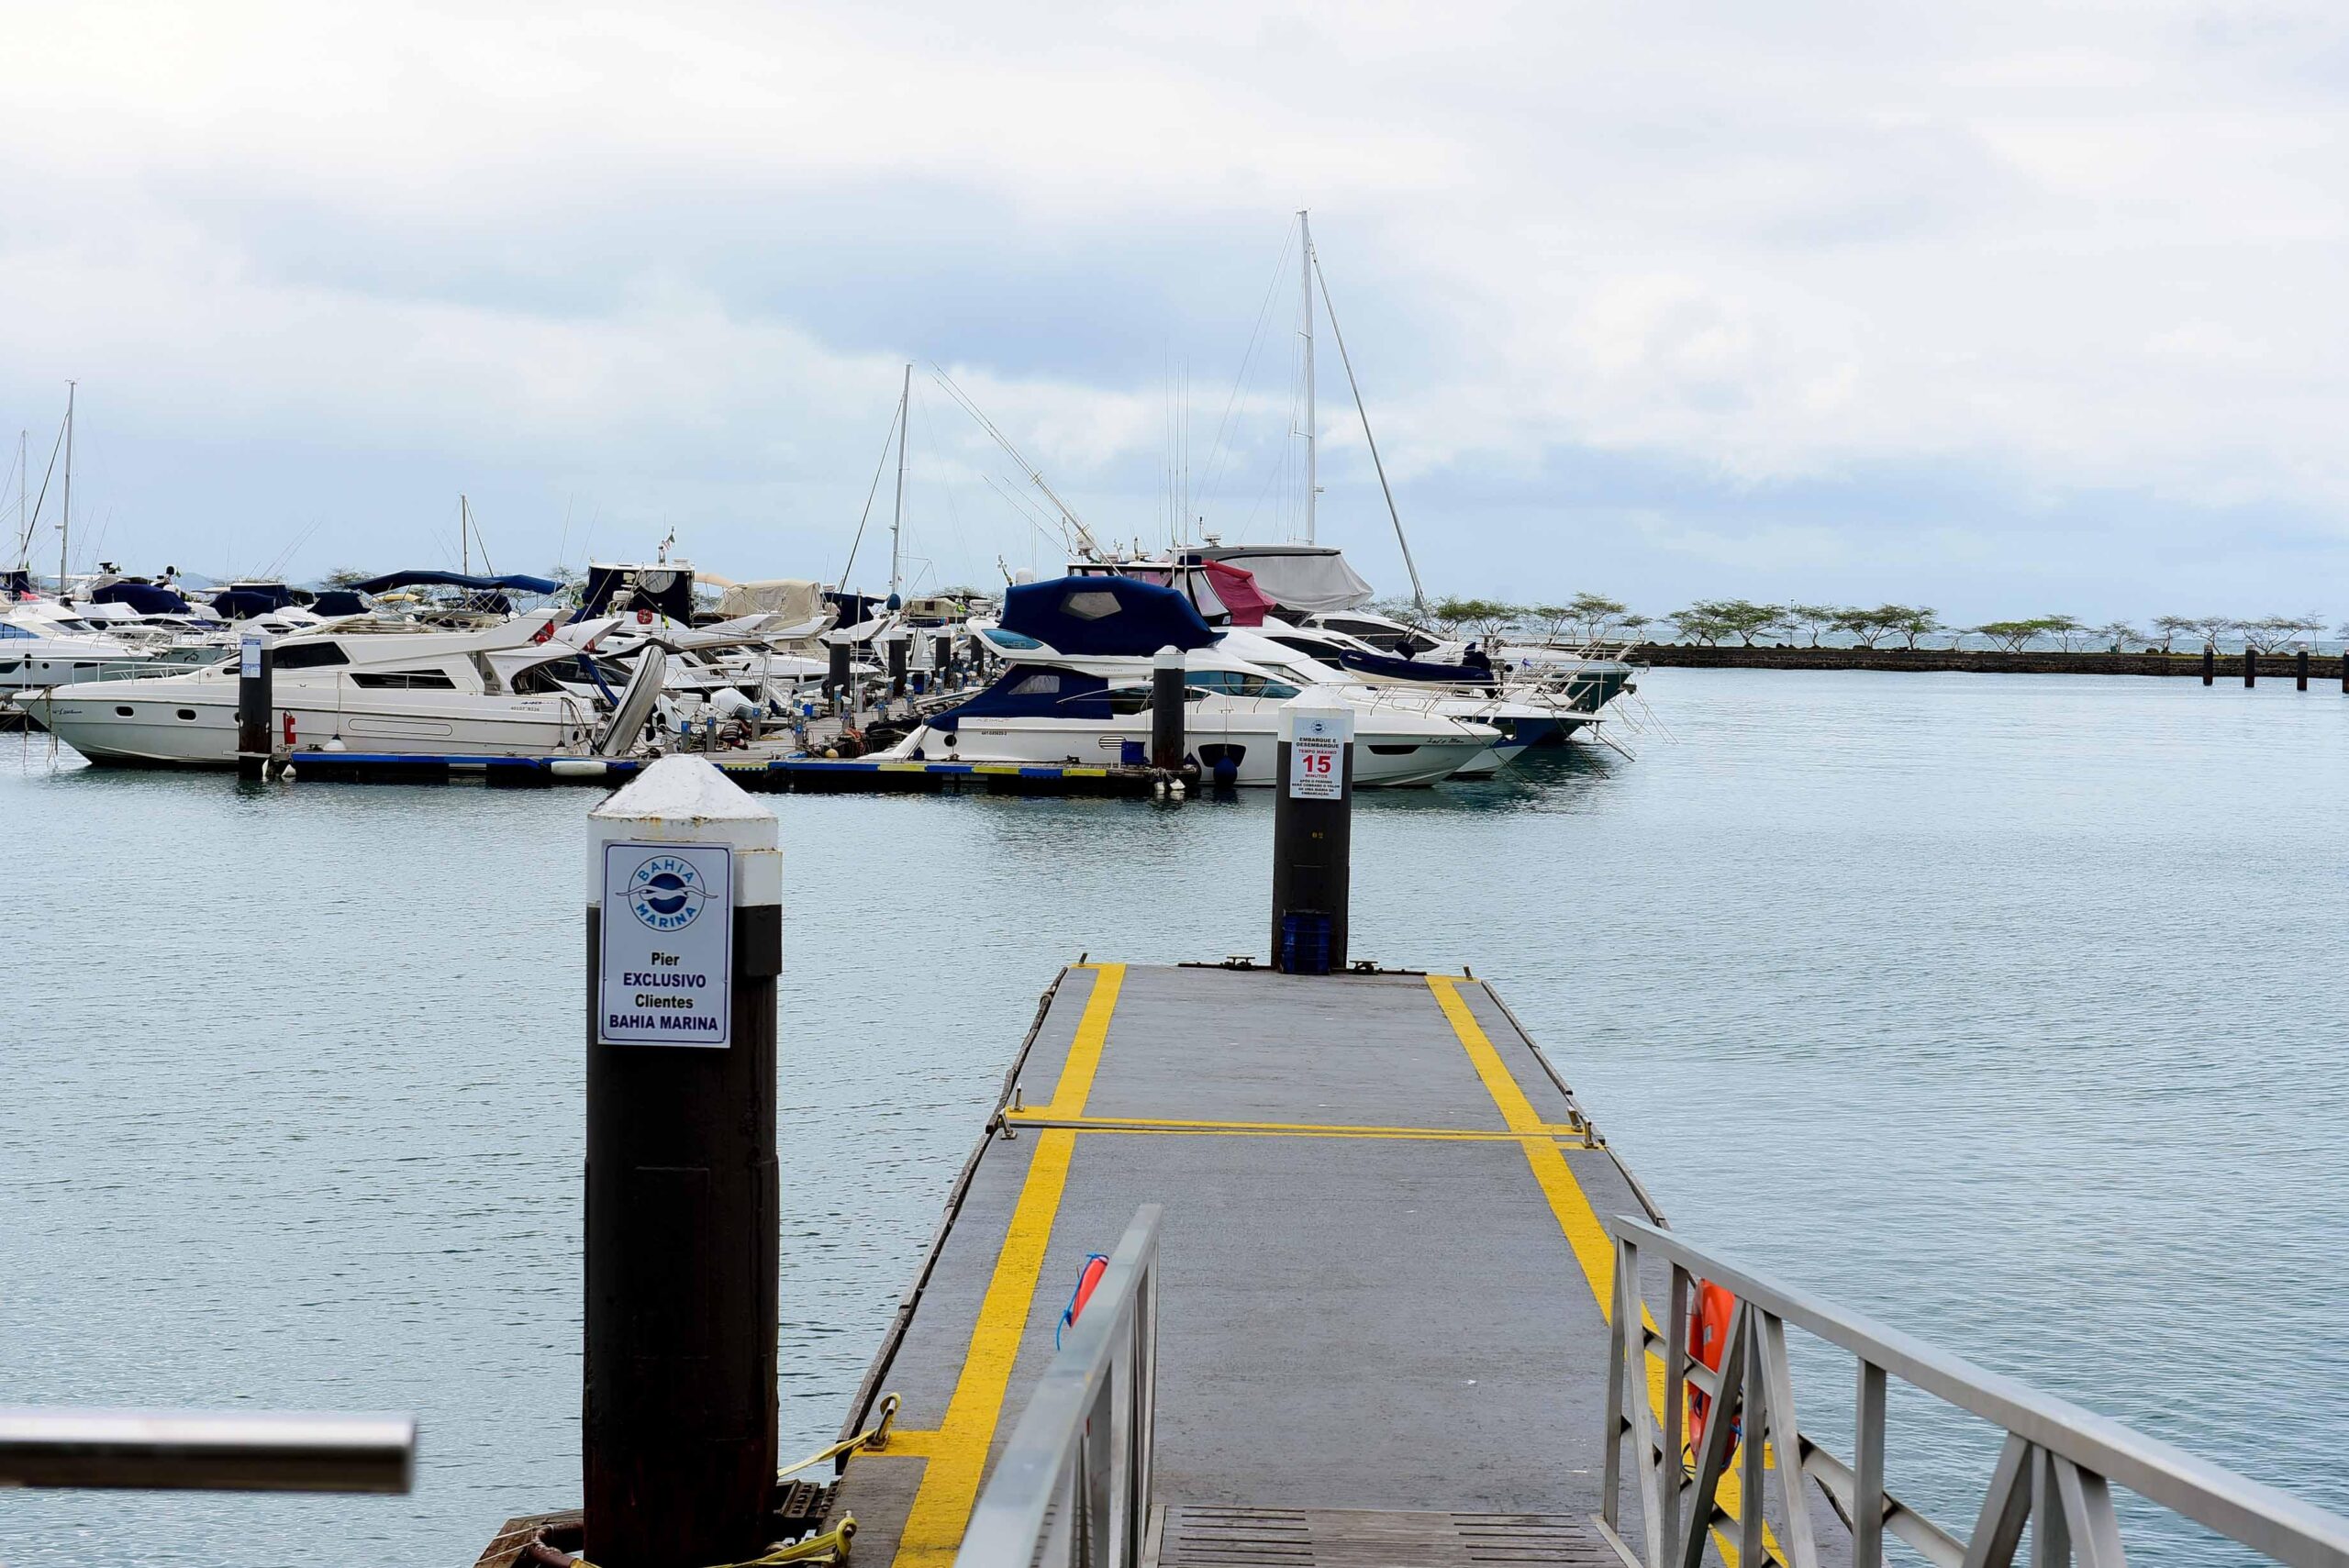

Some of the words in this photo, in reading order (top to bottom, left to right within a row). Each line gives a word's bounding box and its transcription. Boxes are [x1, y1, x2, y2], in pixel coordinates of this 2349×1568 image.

[1303, 755, 1331, 773] 15
[637, 859, 694, 882] BAHIA
[635, 902, 697, 928] MARINA
[651, 951, 680, 966] Pier
[623, 972, 707, 988] EXCLUSIVO
[635, 994, 694, 1009] Clientes
[609, 1014, 655, 1029] BAHIA
[660, 1016, 718, 1031] MARINA
